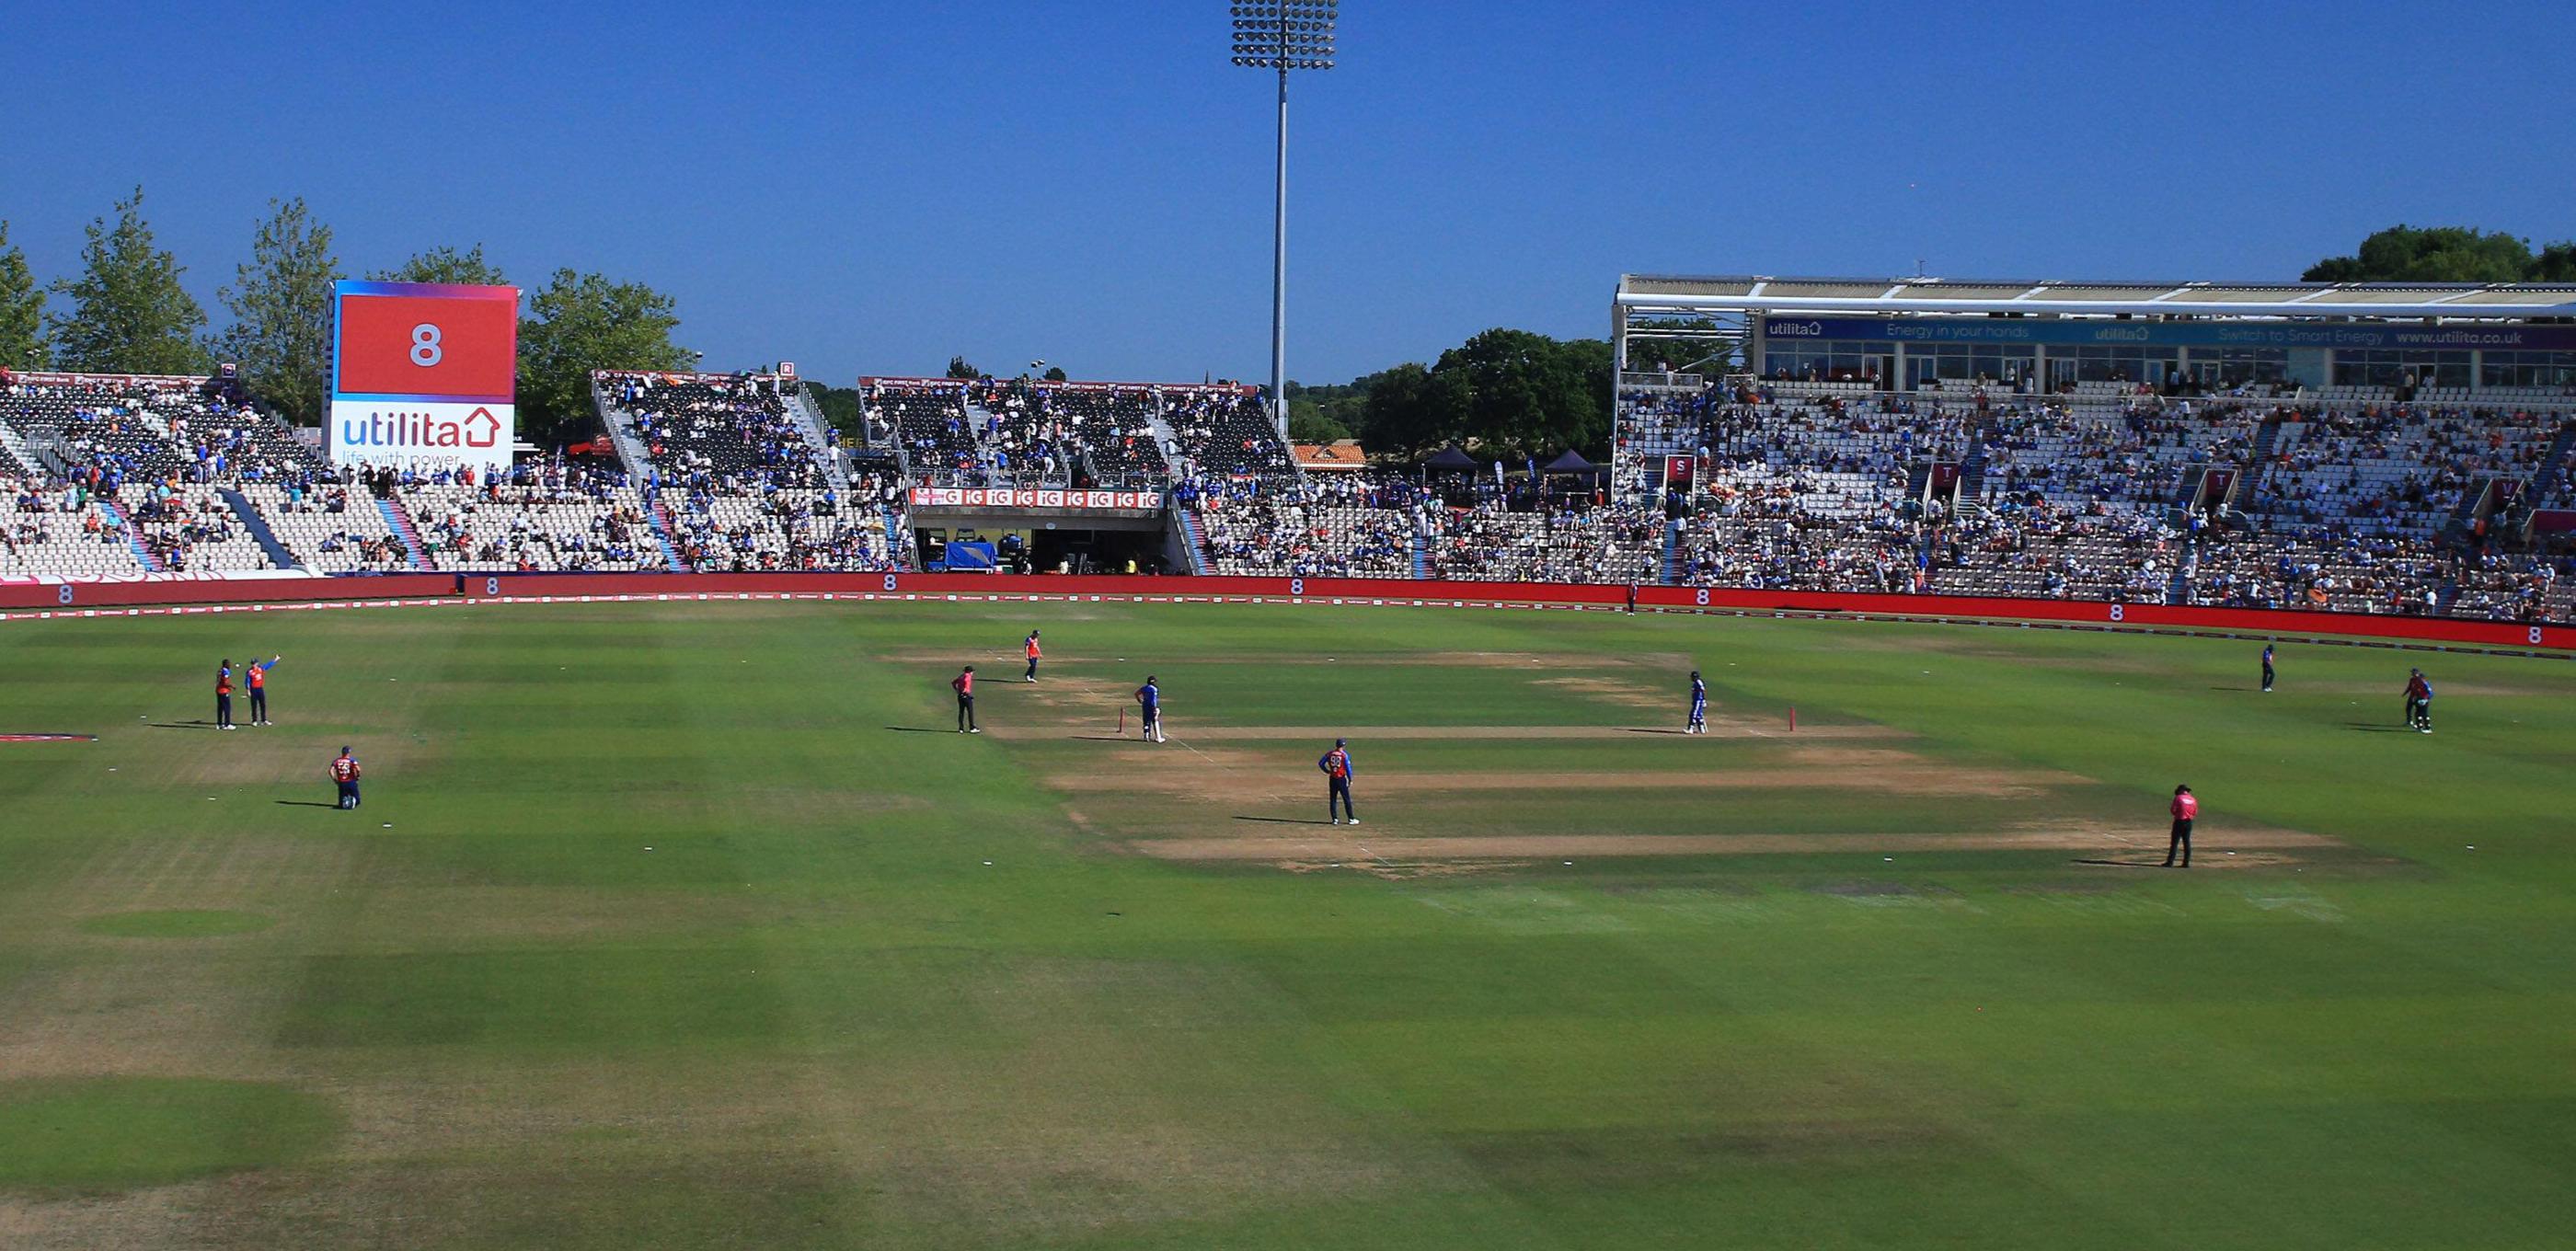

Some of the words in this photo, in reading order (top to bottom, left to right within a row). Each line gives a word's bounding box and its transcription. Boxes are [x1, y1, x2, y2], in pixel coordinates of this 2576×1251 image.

[1770, 322, 1809, 336] utilita
[1887, 323, 1932, 339] Energy
[1937, 325, 1949, 337] in
[1952, 327, 1983, 339] your
[1985, 325, 2029, 338] hands
[2096, 327, 2134, 340] utilita
[2218, 328, 2266, 341] Switch
[2269, 329, 2284, 341] to
[2288, 329, 2330, 342] Smart
[2335, 329, 2385, 346] Energy
[2397, 331, 2523, 344] www.utilita.co.uk
[409, 323, 442, 366] 8
[344, 412, 459, 447] utilita
[341, 451, 365, 464] life
[371, 451, 404, 464] with
[410, 455, 460, 467] power
[1676, 460, 1685, 471] S
[1943, 466, 1952, 477] T
[2217, 474, 2226, 486] T
[2502, 482, 2513, 494] V
[487, 577, 499, 595] 8
[883, 574, 896, 591] 8
[1290, 578, 1304, 595] 8
[59, 584, 73, 603] 8
[1696, 588, 1709, 605] 8
[2110, 603, 2123, 621] 8
[2528, 626, 2541, 644] 8
